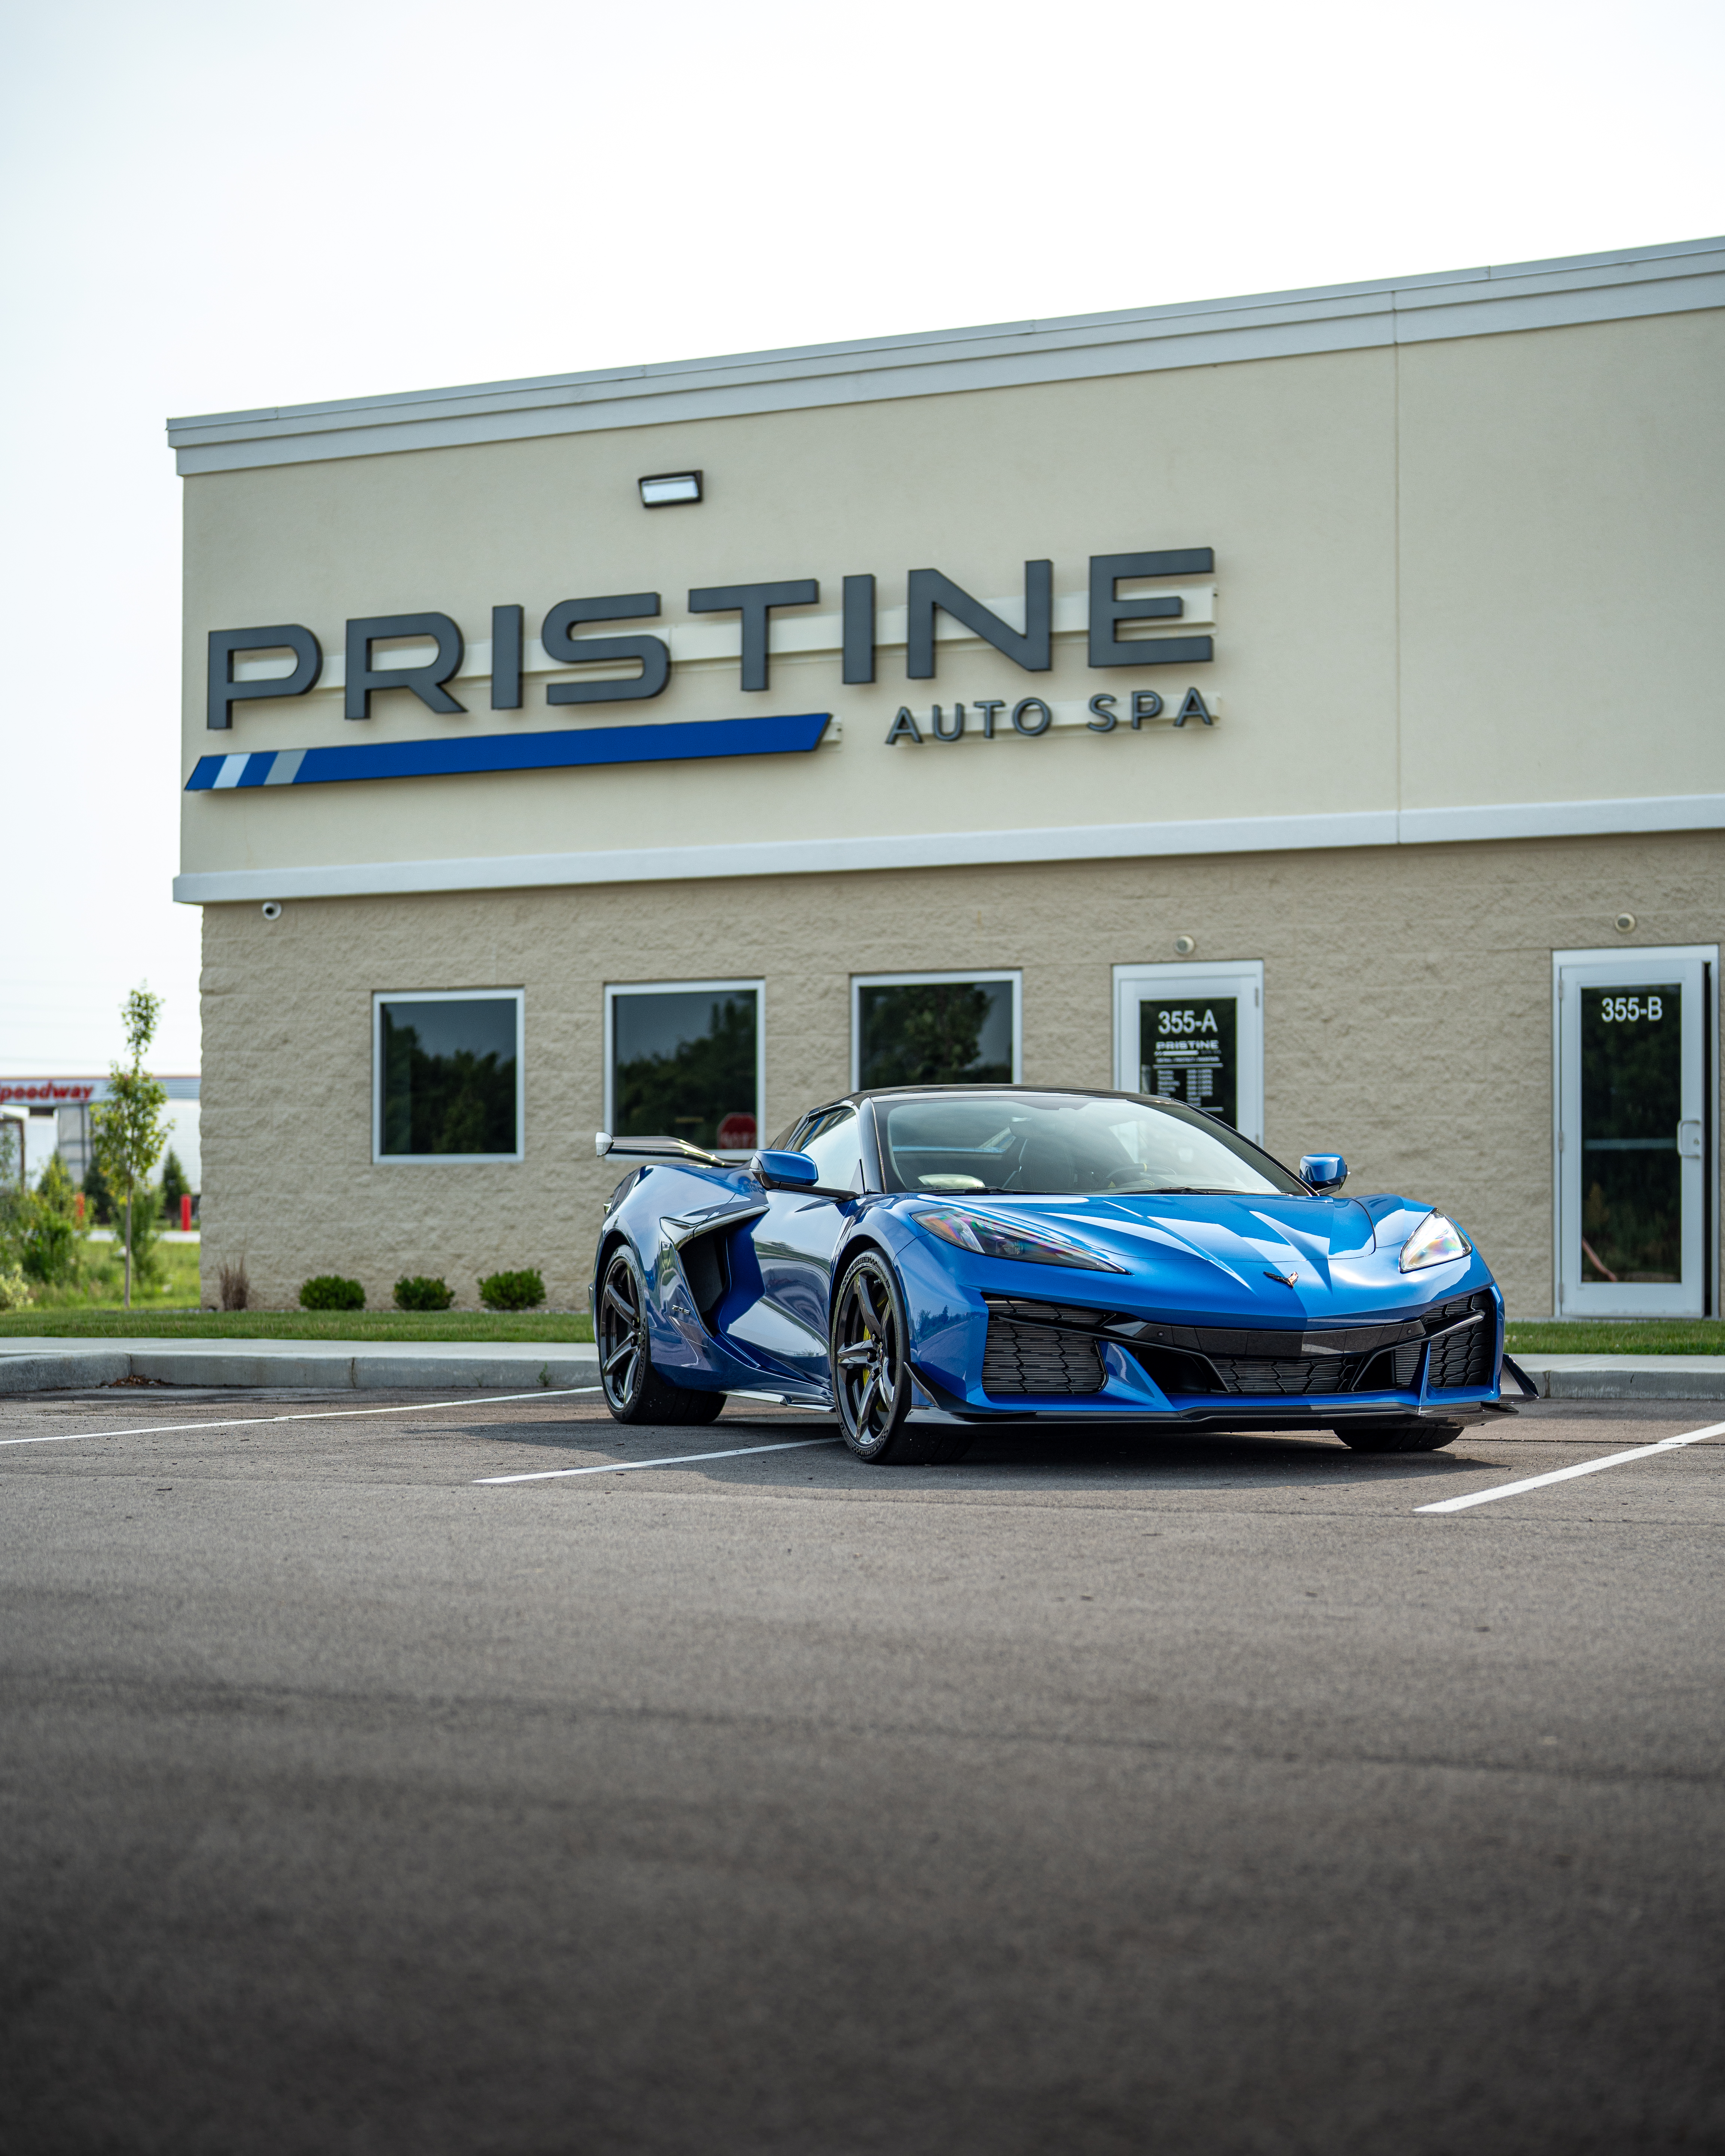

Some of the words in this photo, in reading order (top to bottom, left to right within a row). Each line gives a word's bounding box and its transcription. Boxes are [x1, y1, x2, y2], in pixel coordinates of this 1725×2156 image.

[207, 547, 1214, 730] PRISTINE
[885, 697, 1051, 745] AUTO
[1087, 687, 1213, 733] SPA
[1158, 1009, 1218, 1034] 355-A
[1601, 996, 1663, 1022] 355-B
[1156, 1040, 1219, 1050] PRISTINE
[853, 1257, 869, 1269] MICHELIN
[860, 1446, 876, 1455] MICHELIN
